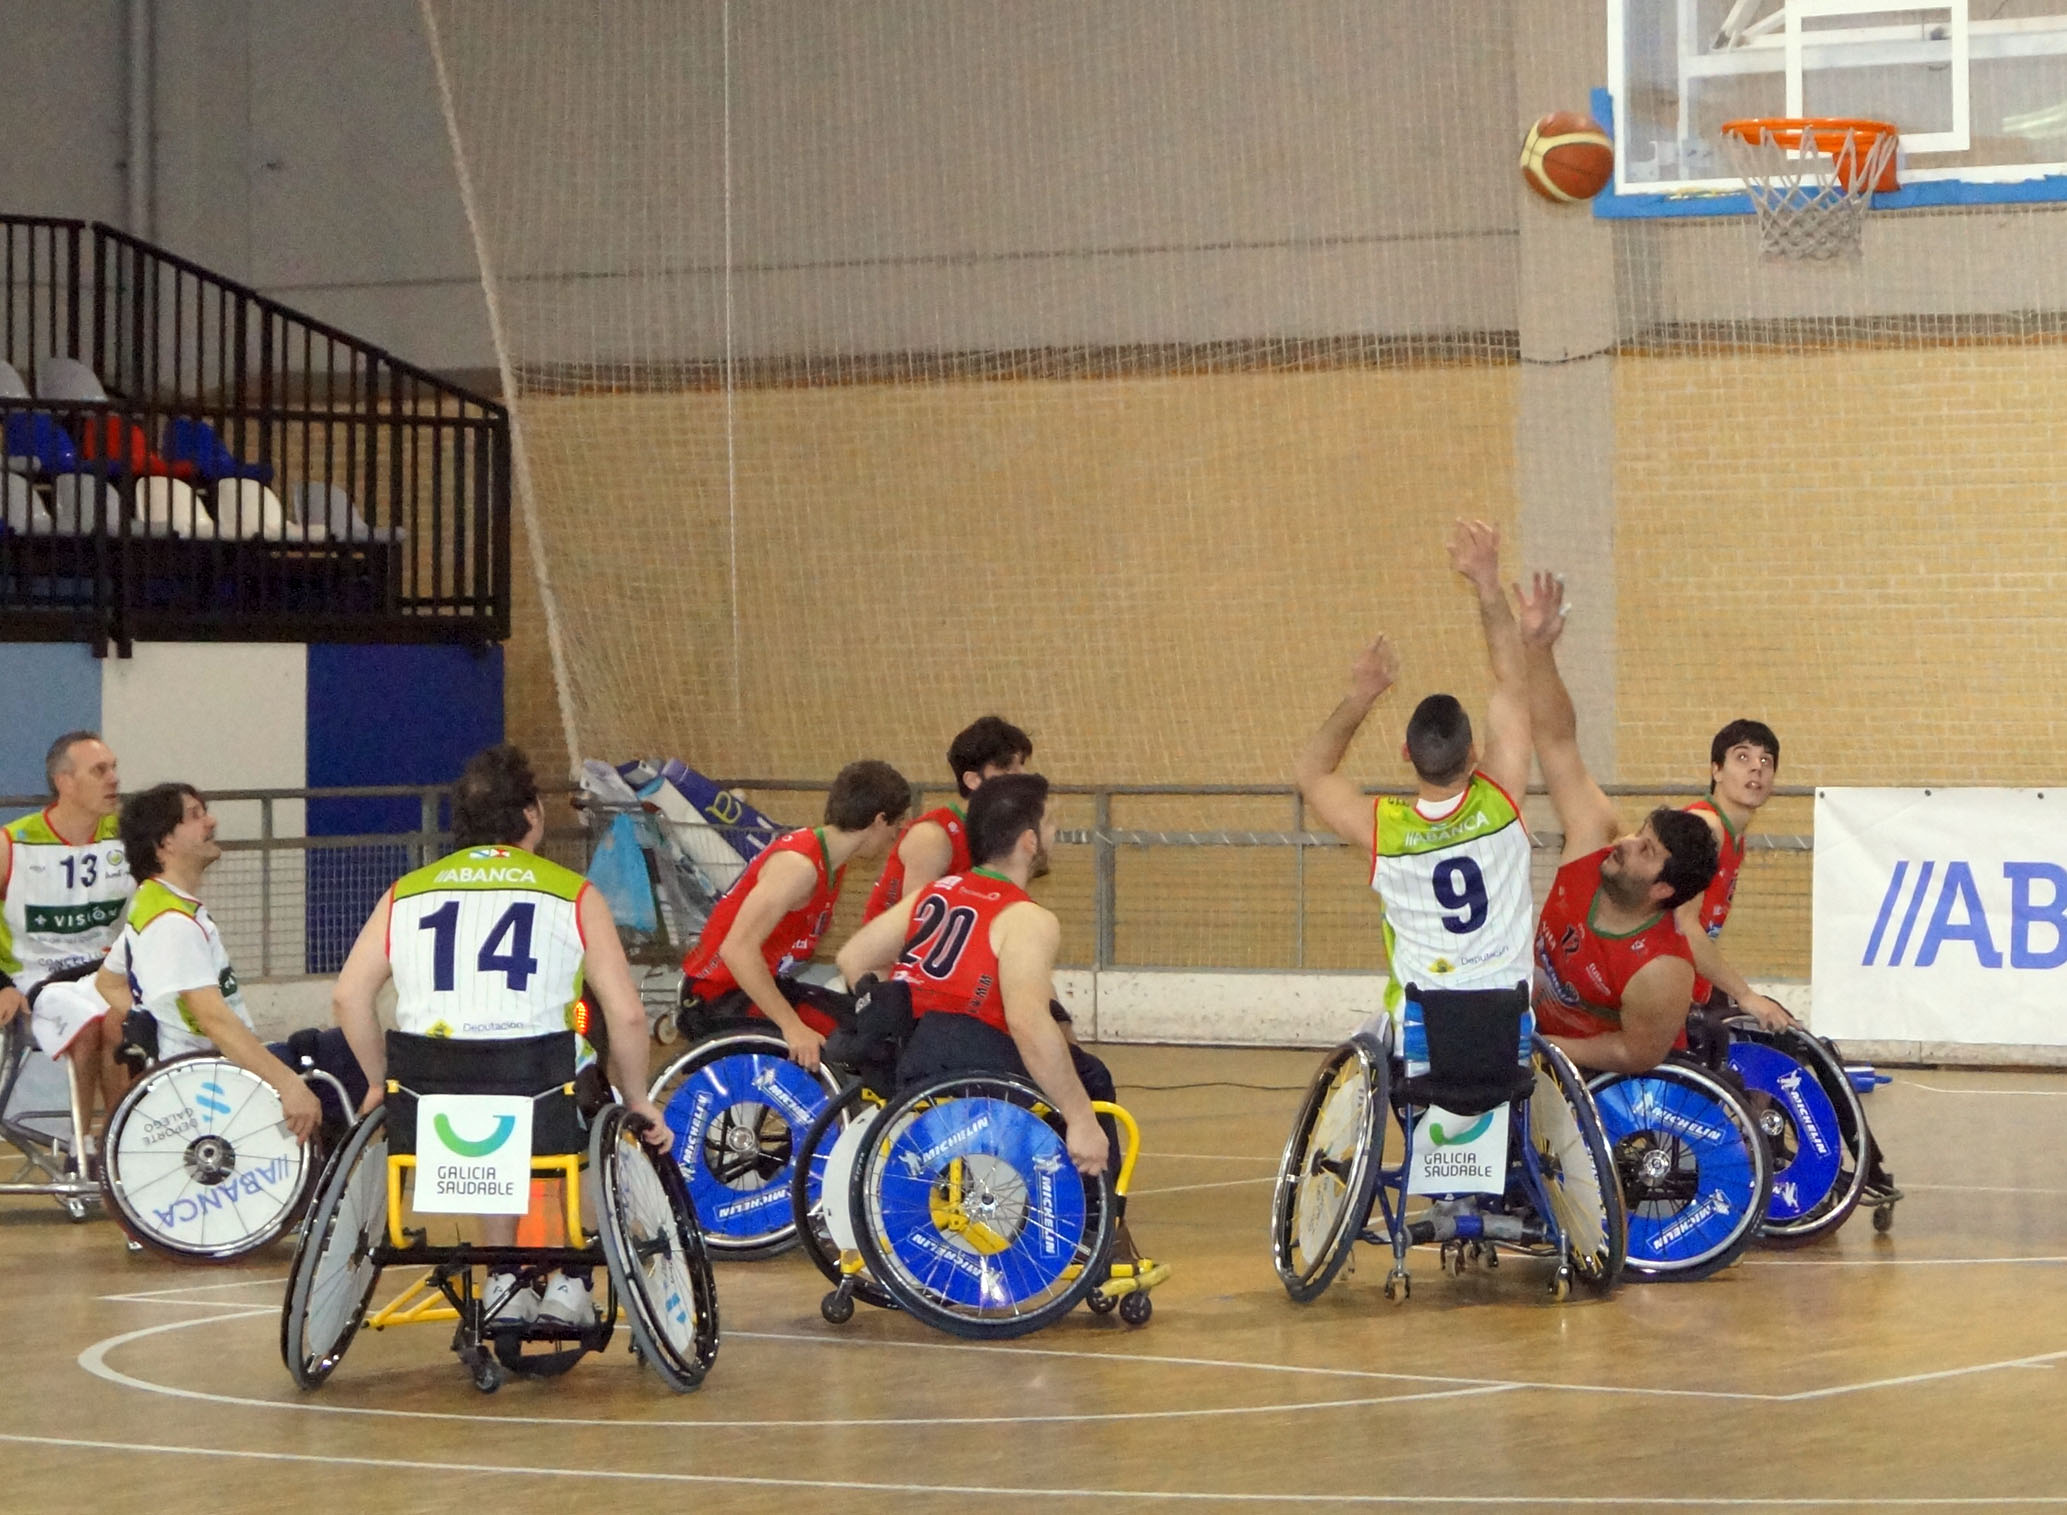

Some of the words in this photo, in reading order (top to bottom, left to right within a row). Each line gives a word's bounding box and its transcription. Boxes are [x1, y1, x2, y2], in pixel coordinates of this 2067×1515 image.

[60, 853, 98, 889] 13
[1432, 856, 1488, 934] 9
[418, 900, 538, 992] 14
[897, 893, 978, 980] 20
[683, 1093, 709, 1164] MICHELIN
[922, 1116, 990, 1164] MICHELIN
[1652, 1106, 1722, 1140] MICHELIN
[1791, 1091, 1827, 1154] MICHELIN
[437, 1166, 496, 1181] GALICIA
[1424, 1153, 1476, 1165] GALICIA
[1424, 1165, 1492, 1178] SAUDABLE
[437, 1181, 514, 1196] SAUDABLE
[718, 1189, 787, 1218] MICHELIN
[1041, 1175, 1056, 1255] MICHELIN
[1652, 1203, 1712, 1250] MICHELIN
[912, 1233, 983, 1278] MICHELIN
